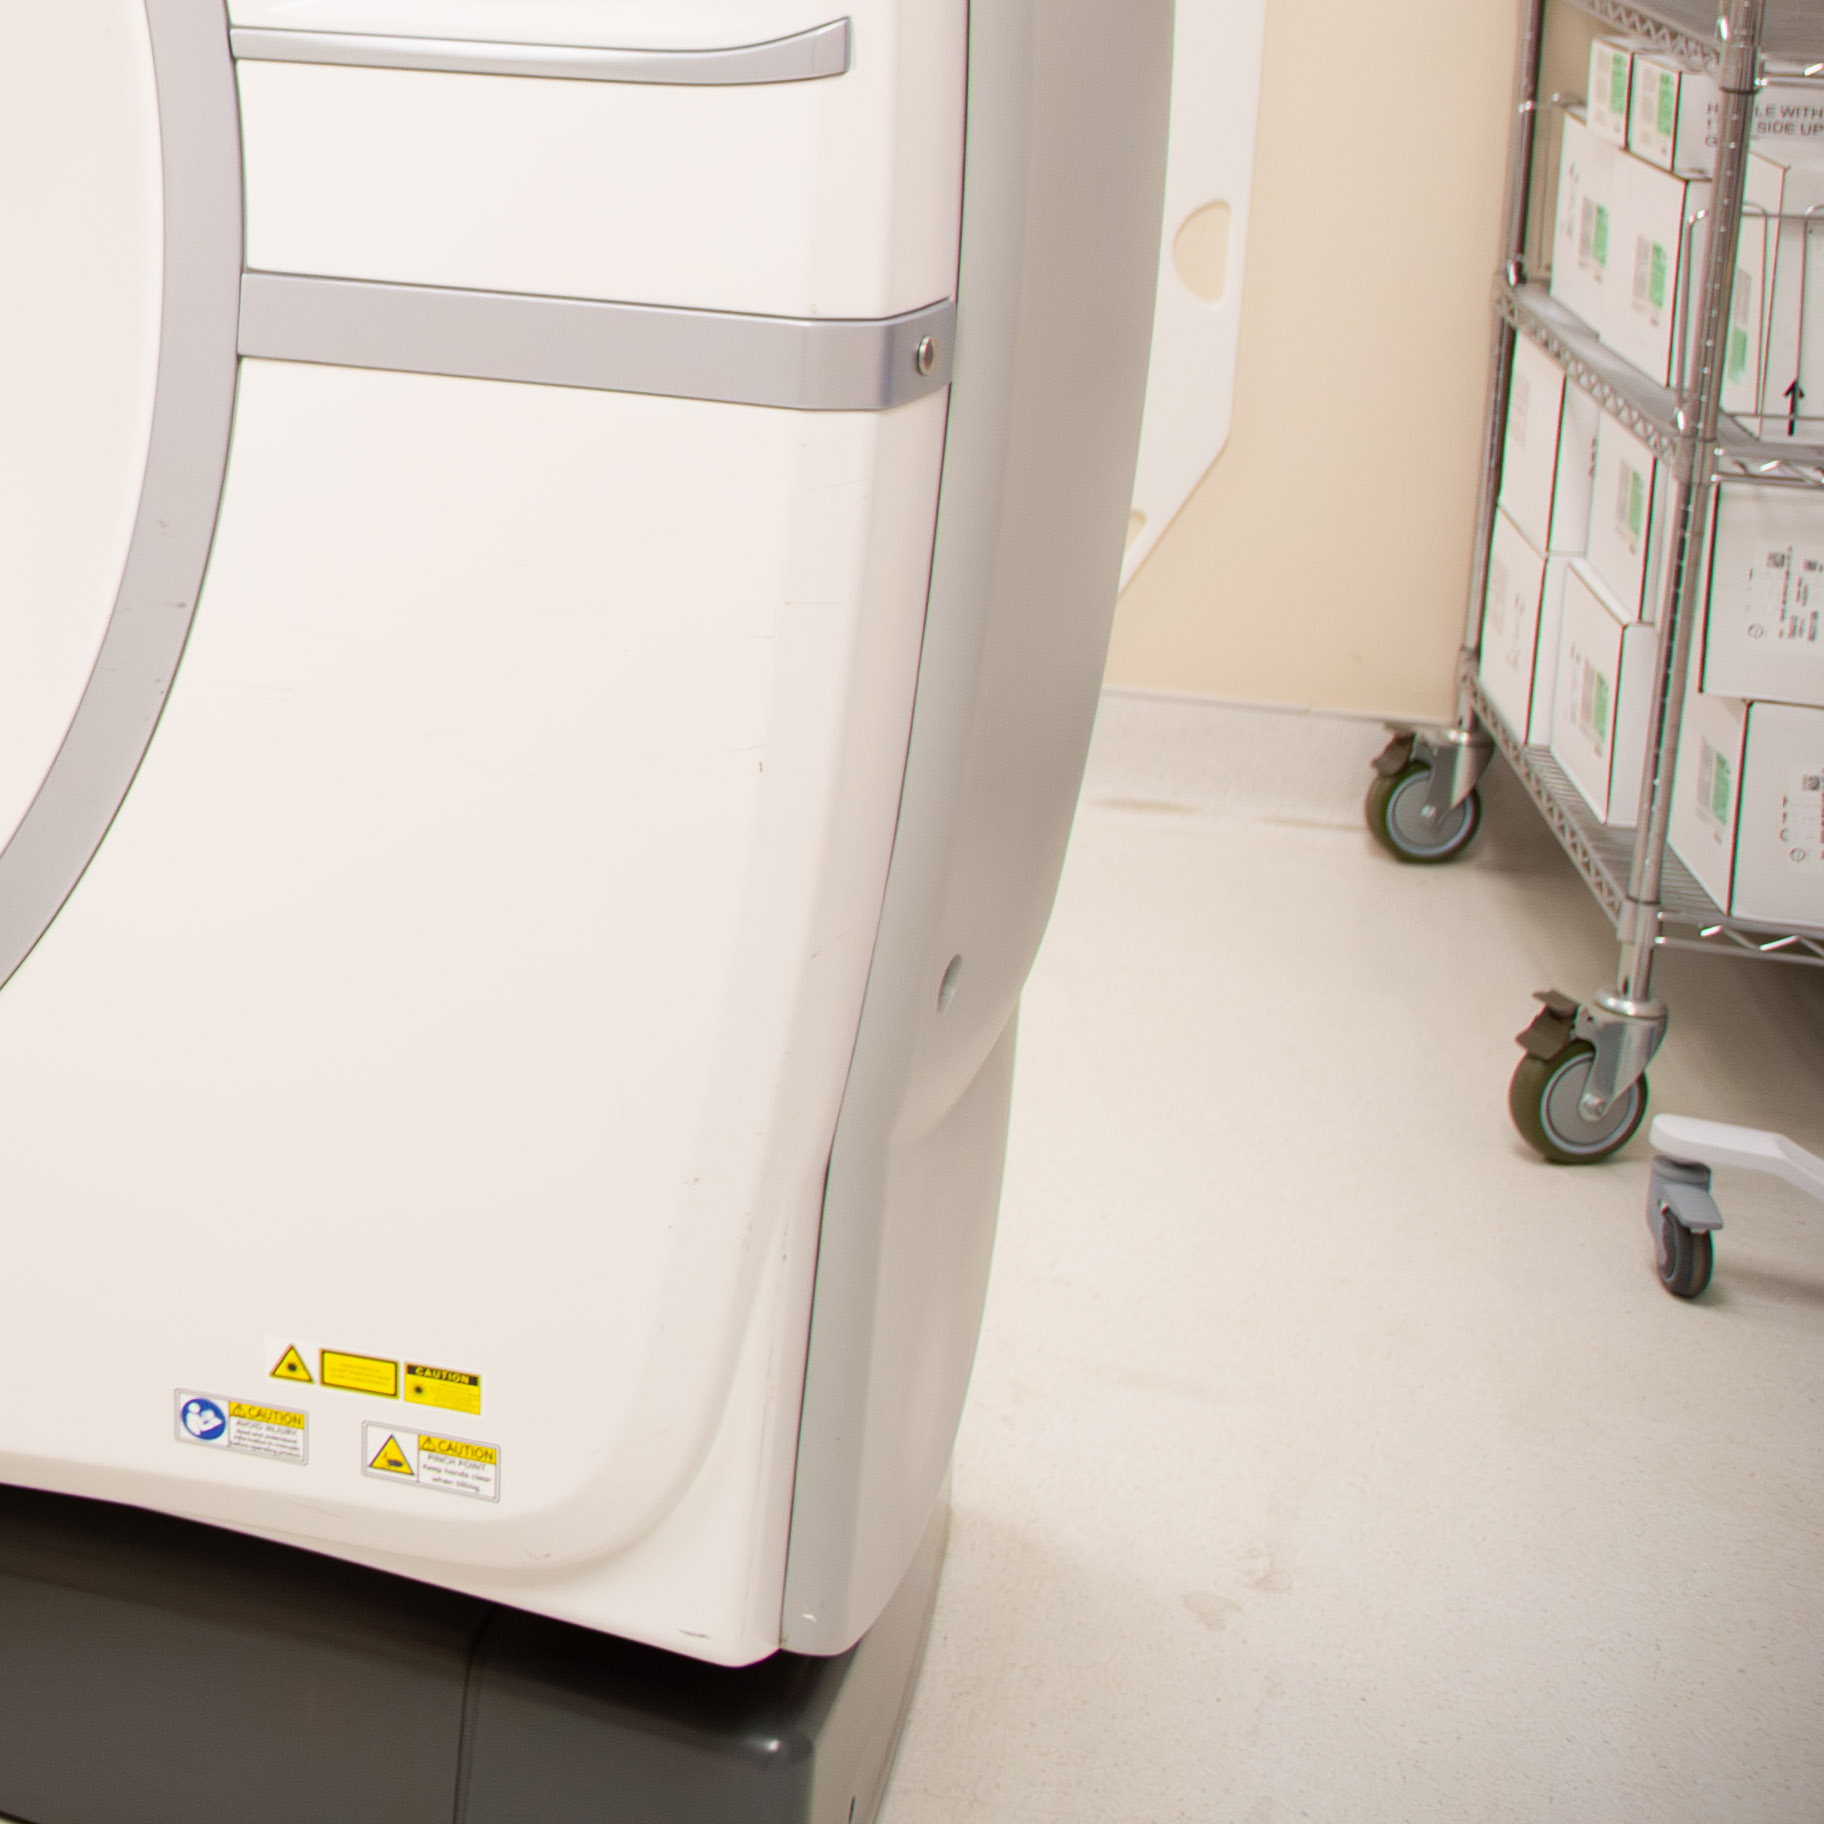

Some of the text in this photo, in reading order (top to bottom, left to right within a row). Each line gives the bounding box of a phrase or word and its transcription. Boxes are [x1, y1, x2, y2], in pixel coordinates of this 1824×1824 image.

[414, 1366, 470, 1385] CAUTION
[248, 1407, 302, 1426] CAUTION
[438, 1439, 493, 1461] CAUTION
[427, 1453, 487, 1471] PINCH POINT
